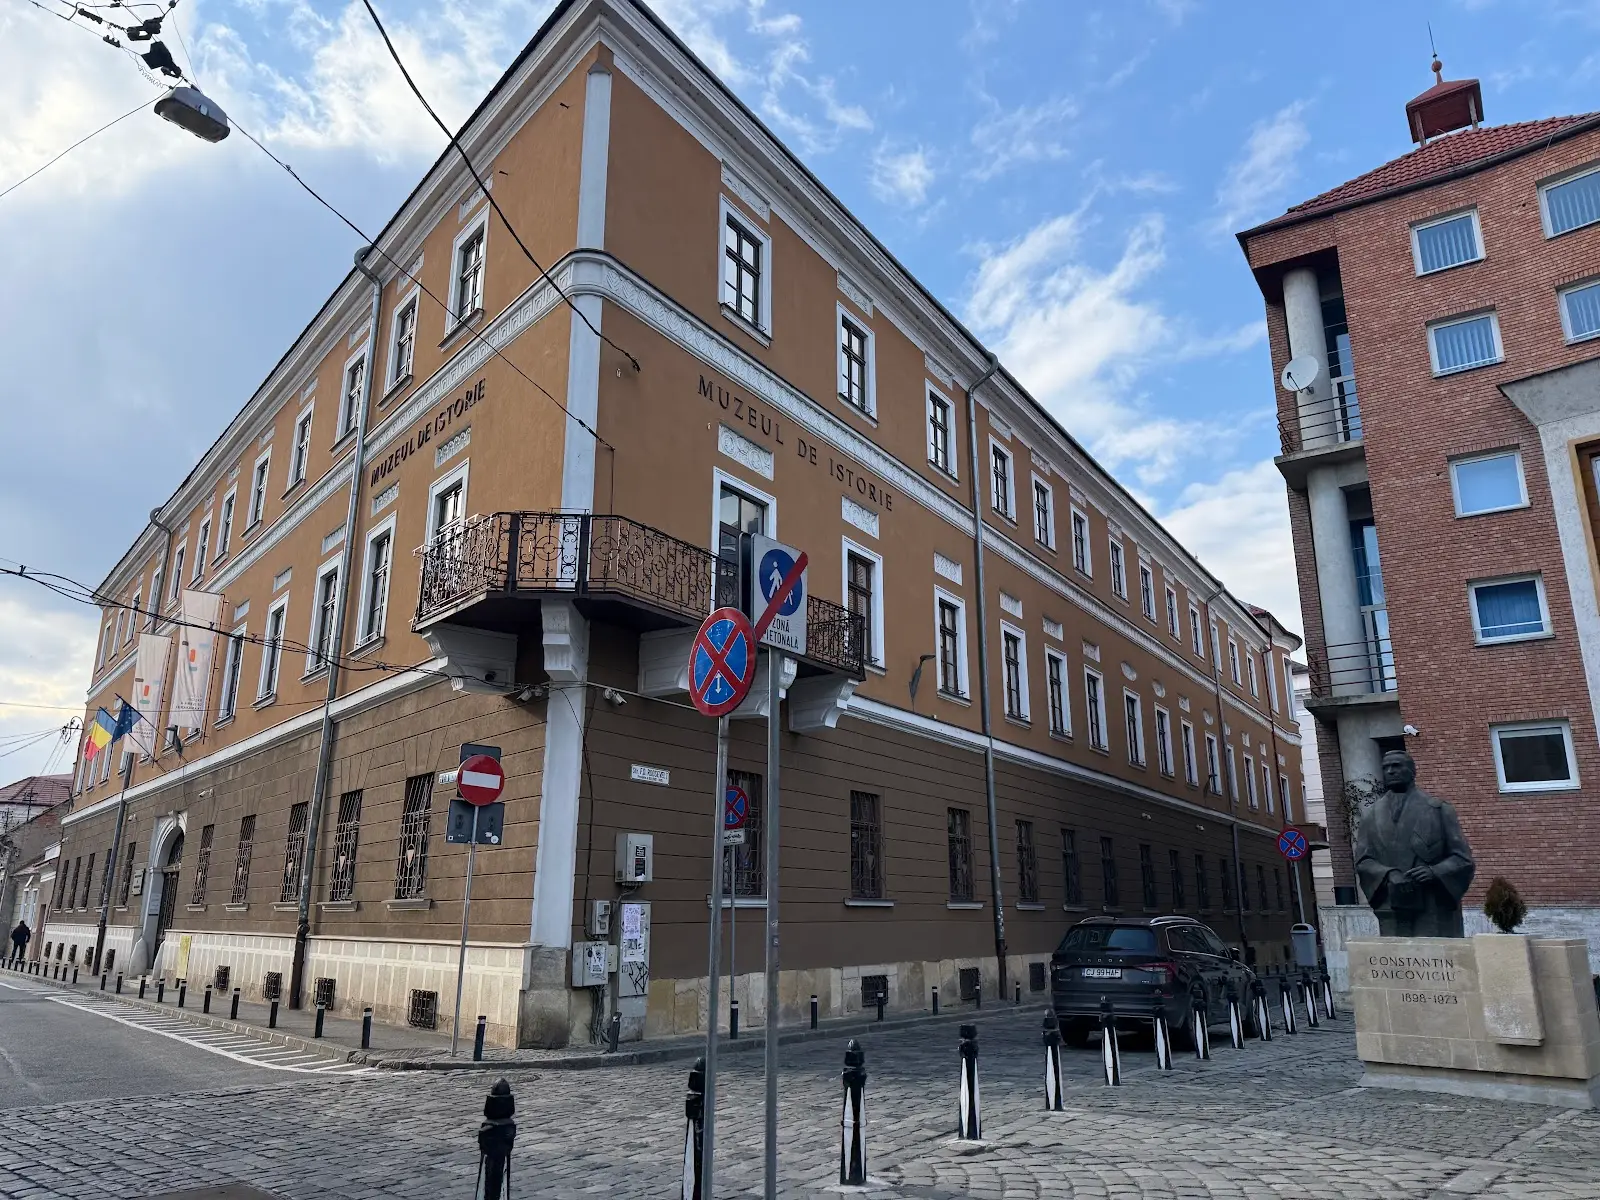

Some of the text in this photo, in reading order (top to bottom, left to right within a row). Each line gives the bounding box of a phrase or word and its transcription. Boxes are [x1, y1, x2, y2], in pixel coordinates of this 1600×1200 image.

[371, 378, 486, 487] MUZEUL DE ISTORIE
[697, 375, 893, 512] MUZEUL DE ISTORIE
[1369, 956, 1455, 969] CONSTANTIN
[1096, 968, 1105, 976] 99
[1371, 969, 1457, 982] DAICOVICIU
